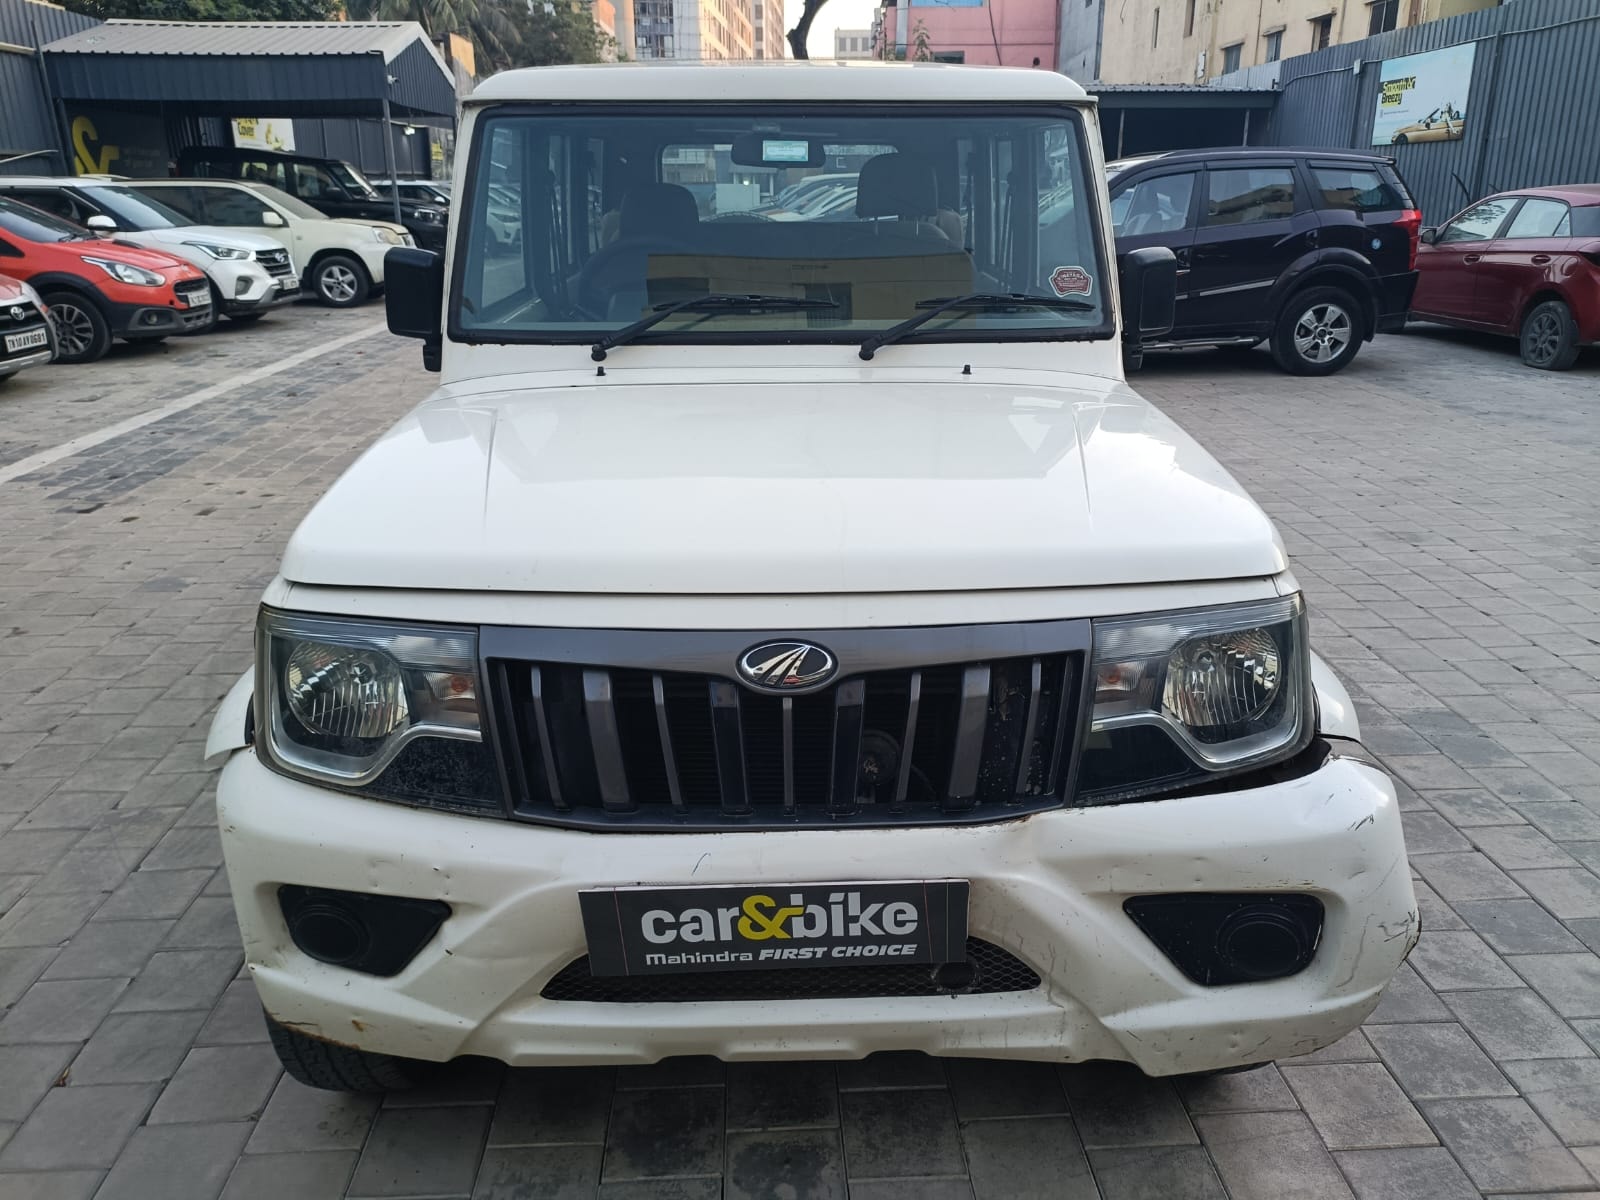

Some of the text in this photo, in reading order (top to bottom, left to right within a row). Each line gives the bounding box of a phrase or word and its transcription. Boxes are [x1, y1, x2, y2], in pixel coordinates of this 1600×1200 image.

[1381, 92, 1402, 105] Breezy
[645, 944, 918, 966] Mahindra FIRST CHOICE
